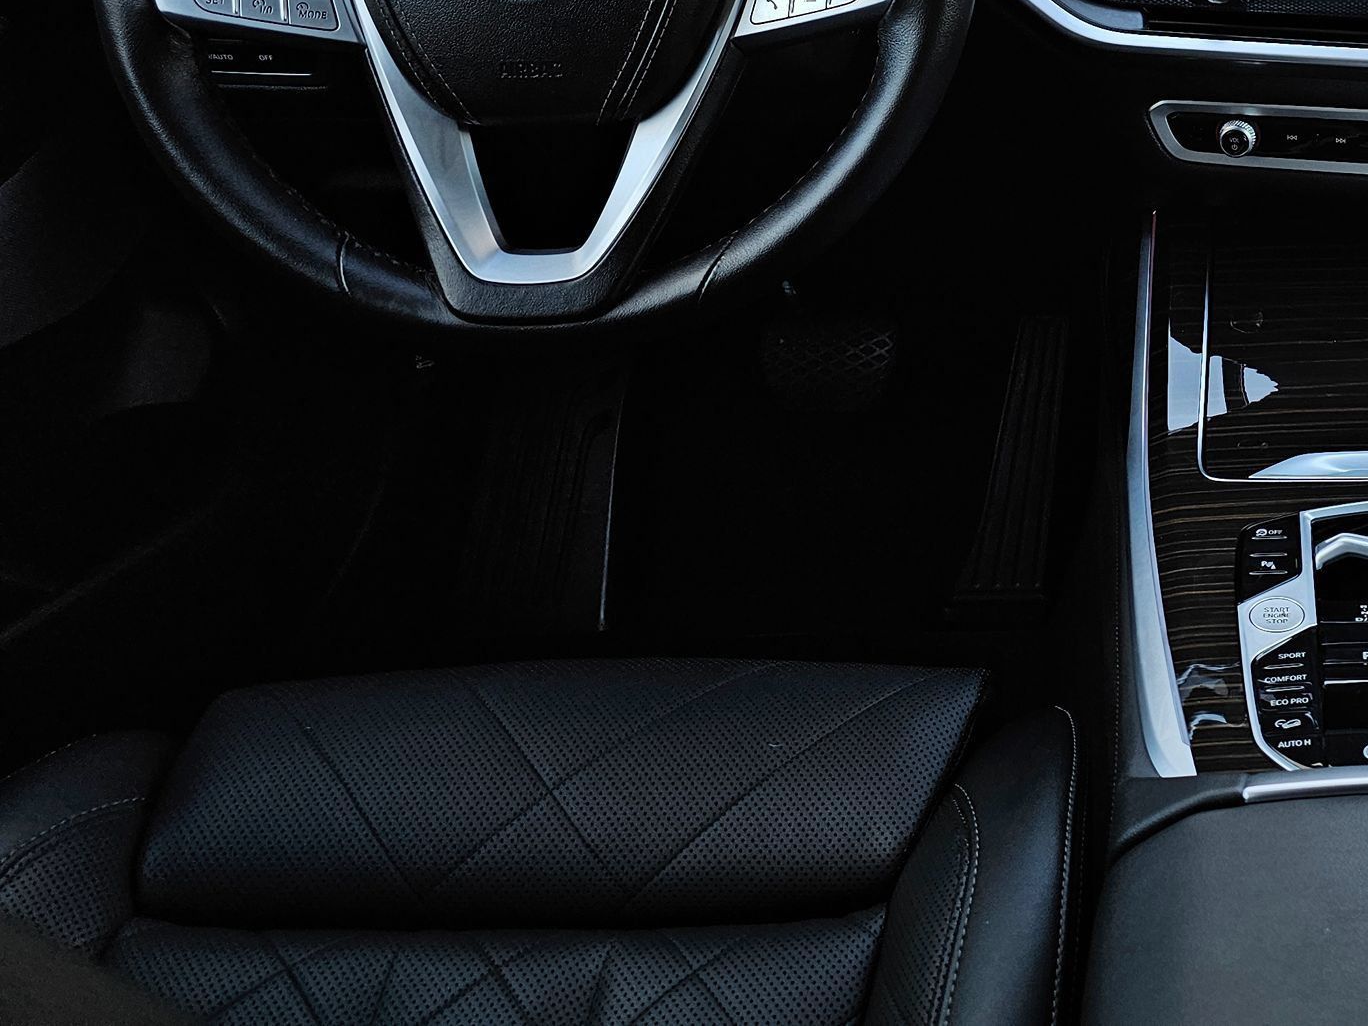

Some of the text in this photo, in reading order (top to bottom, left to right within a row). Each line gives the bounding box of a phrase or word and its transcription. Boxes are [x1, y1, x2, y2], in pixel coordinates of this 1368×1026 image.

[1278, 652, 1306, 660] SPORT
[1264, 674, 1307, 683] COMFORT
[1278, 740, 1302, 748] AUTO
